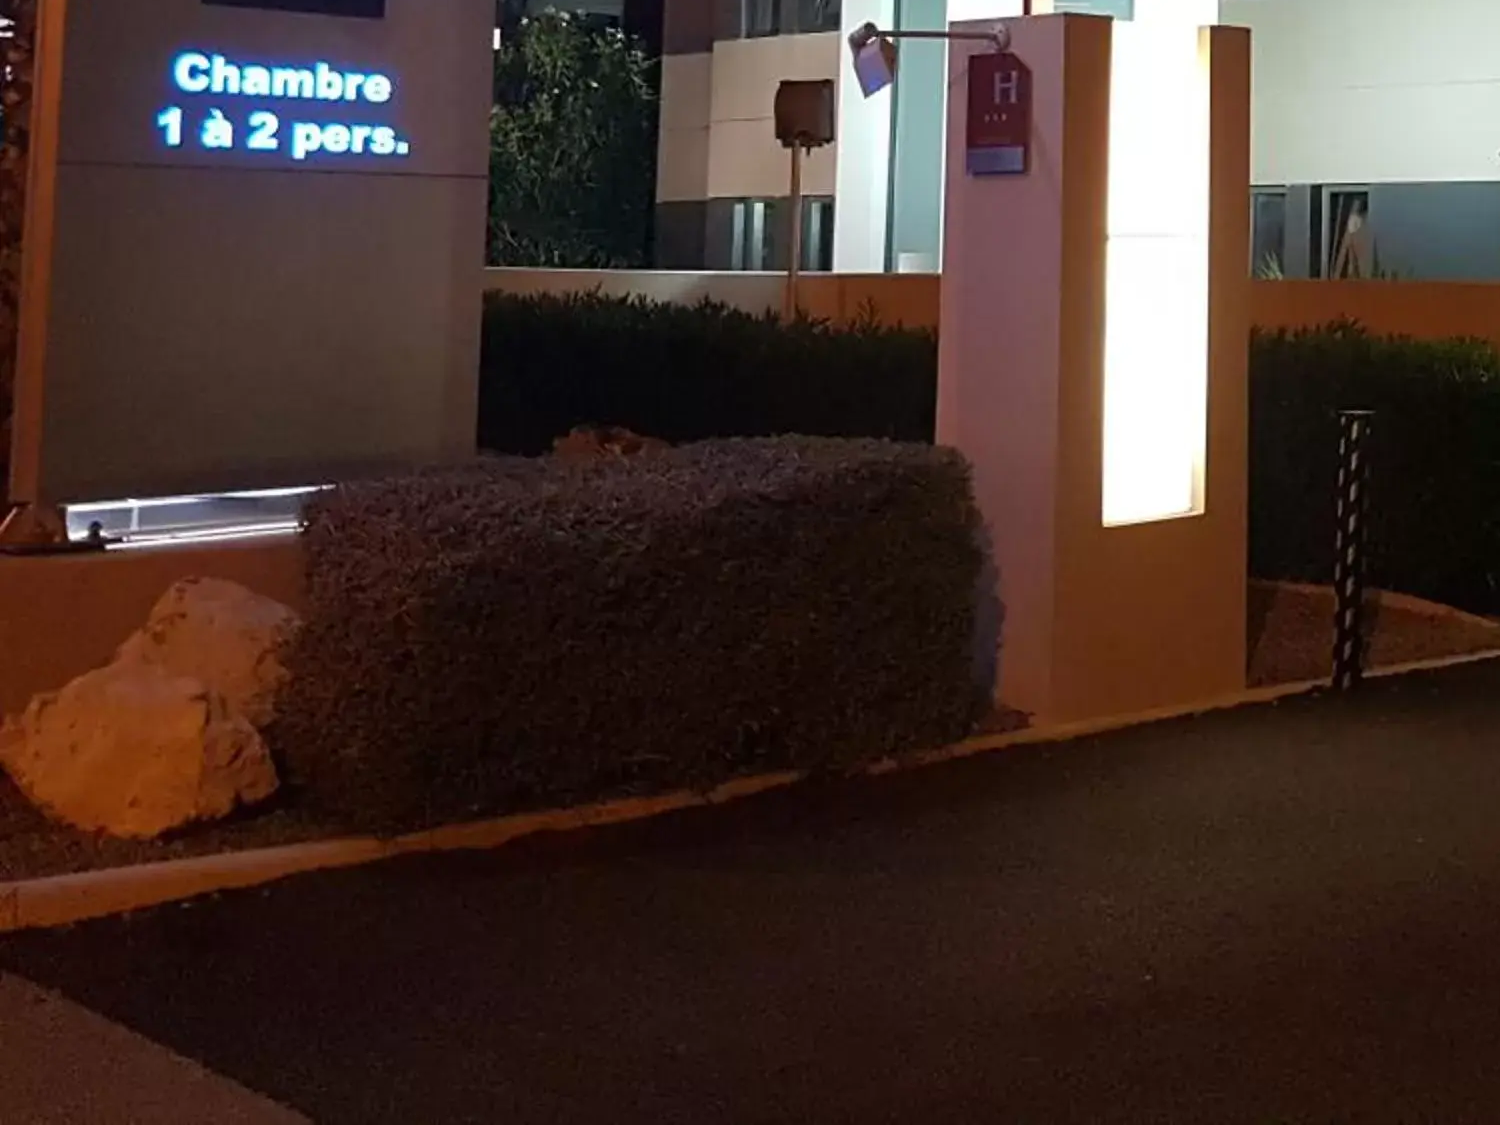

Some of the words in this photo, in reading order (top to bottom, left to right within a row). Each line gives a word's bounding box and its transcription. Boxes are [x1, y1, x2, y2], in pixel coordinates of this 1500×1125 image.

[173, 51, 392, 103] Chambre
[993, 70, 1018, 105] H
[157, 106, 182, 146] 1
[200, 107, 233, 148] à
[246, 111, 279, 150] 2
[291, 121, 409, 160] pers.
